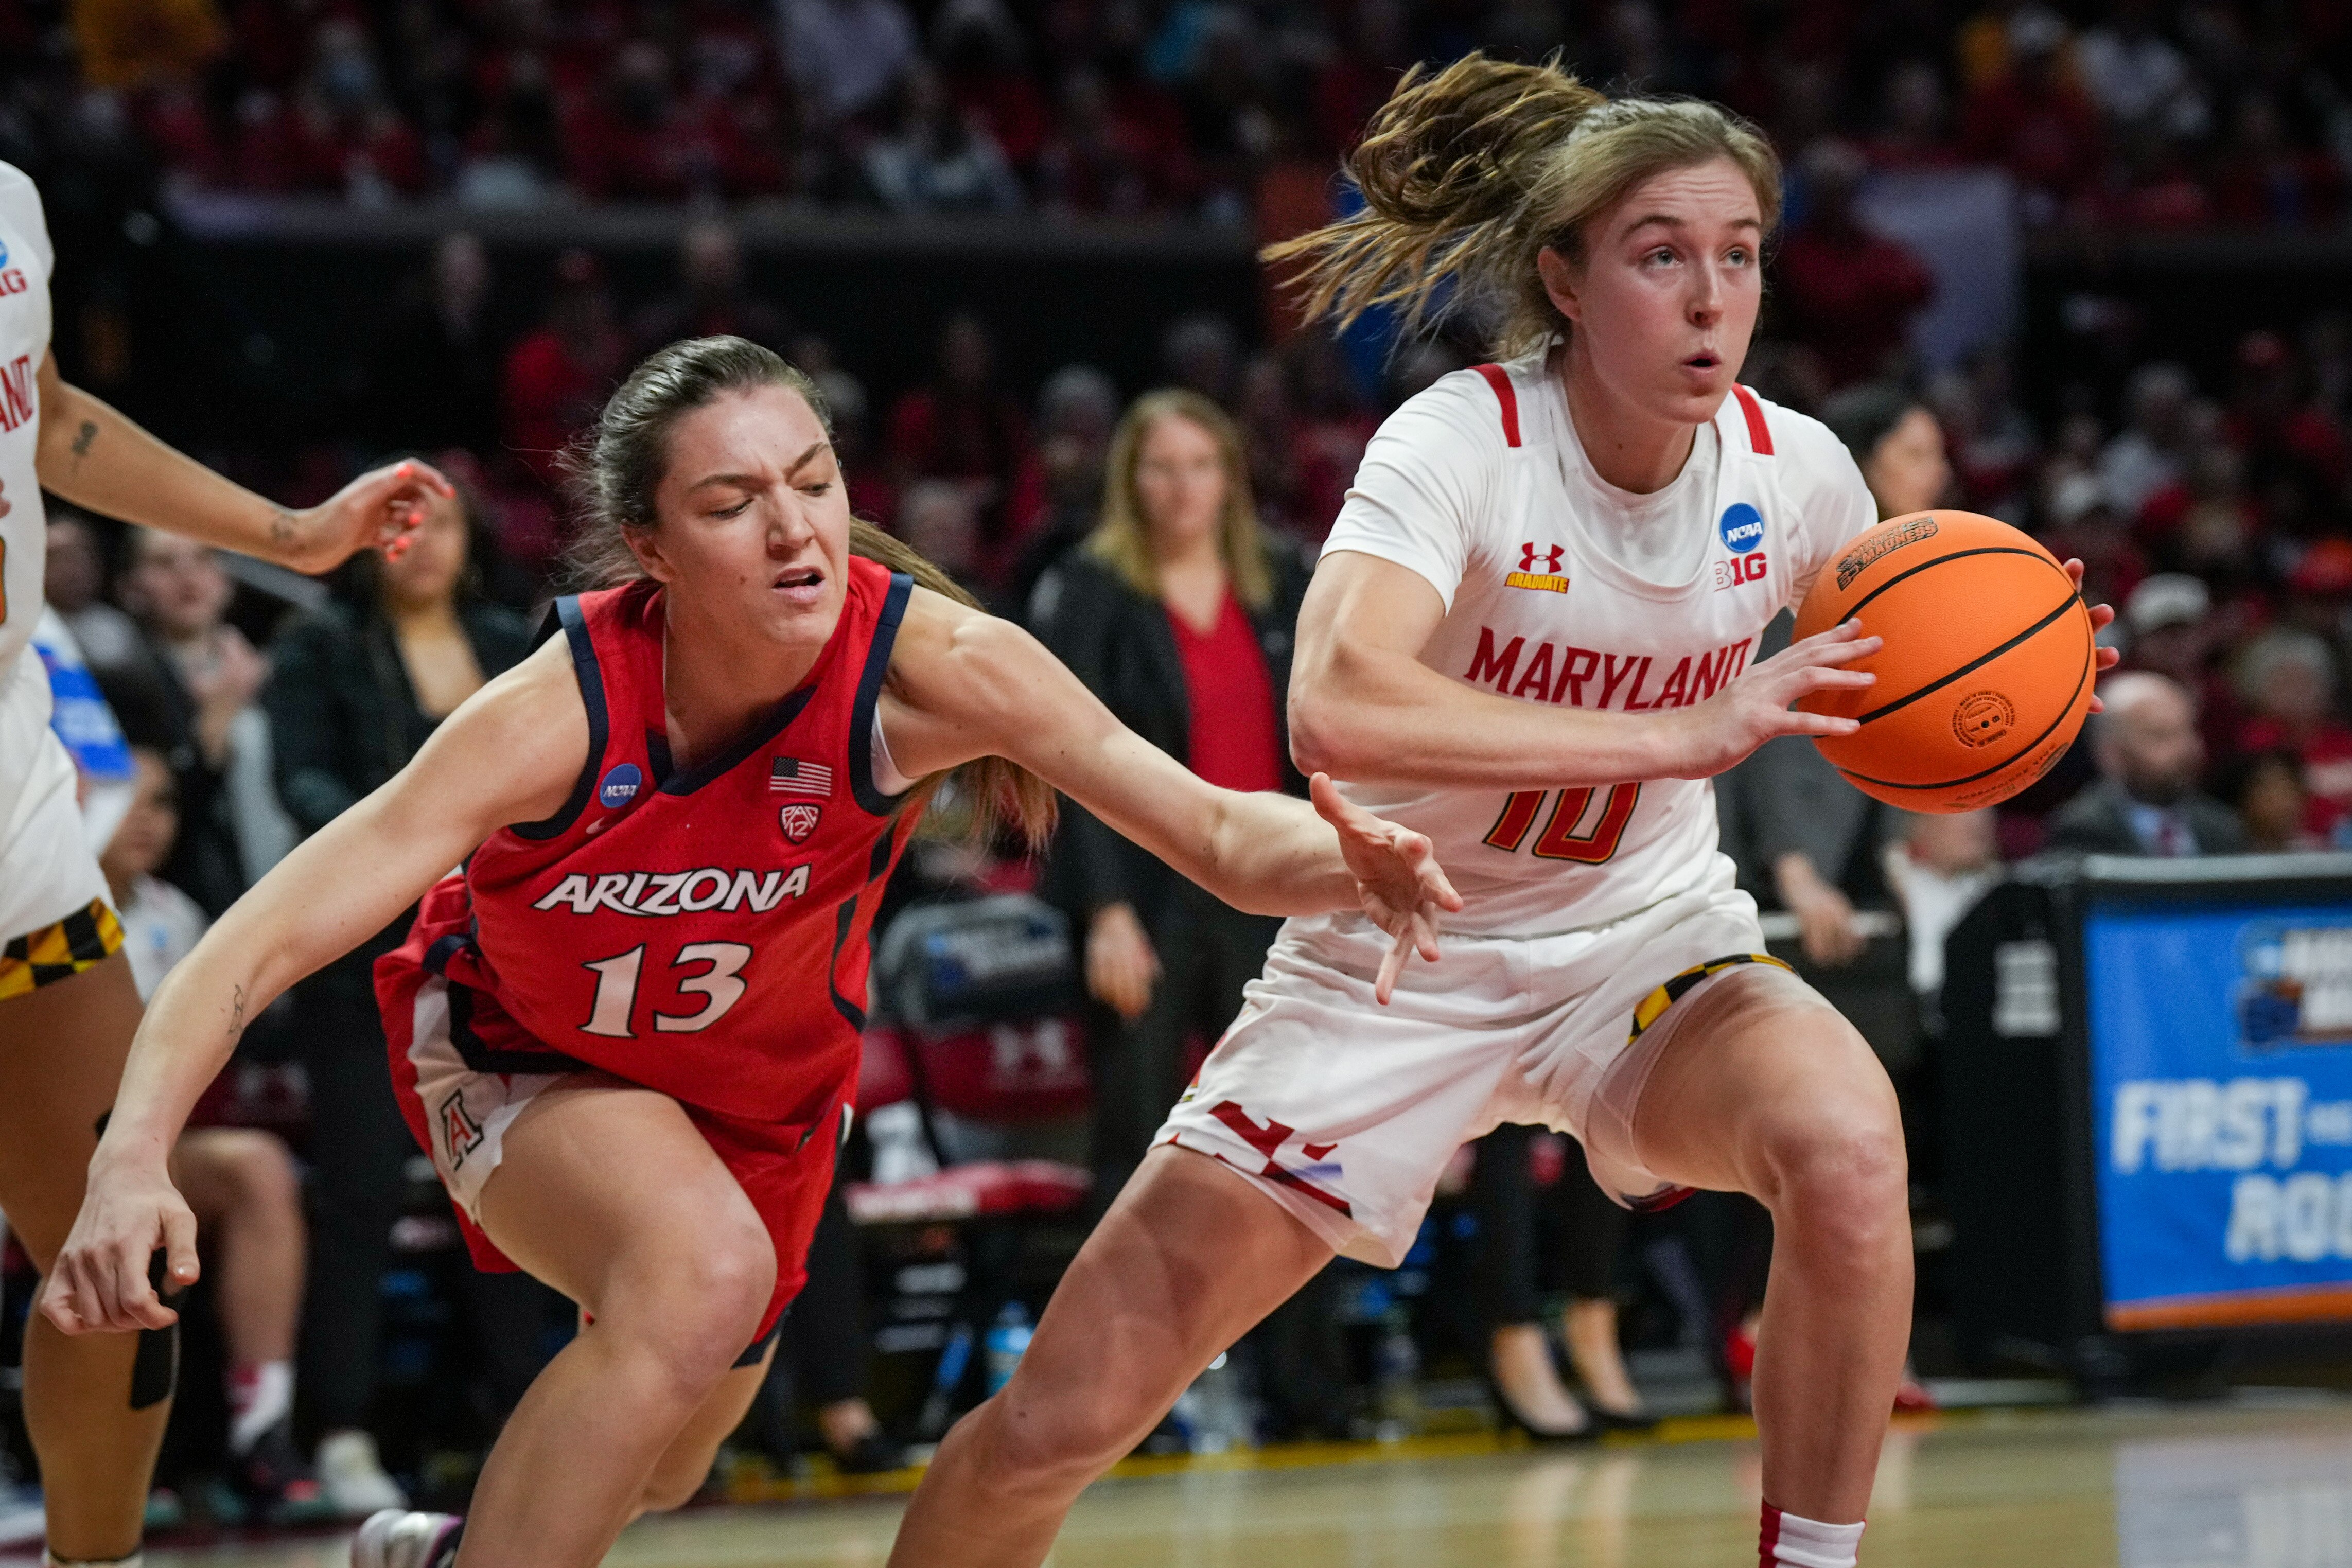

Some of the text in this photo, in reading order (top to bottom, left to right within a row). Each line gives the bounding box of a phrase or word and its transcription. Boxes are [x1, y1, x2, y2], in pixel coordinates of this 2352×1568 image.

[1726, 521, 1764, 544] NCAA
[1861, 523, 1938, 565] MADNESS
[1505, 571, 1569, 594] GRADUATE
[1464, 625, 1752, 711] MARYLAND
[603, 784, 637, 798] NCAA
[782, 805, 819, 830] PAC
[789, 821, 808, 837] 12
[531, 862, 812, 918] ARIZONA
[576, 940, 753, 1039] 13
[440, 1087, 484, 1171] A
[2112, 1079, 2307, 1174] FIRST
